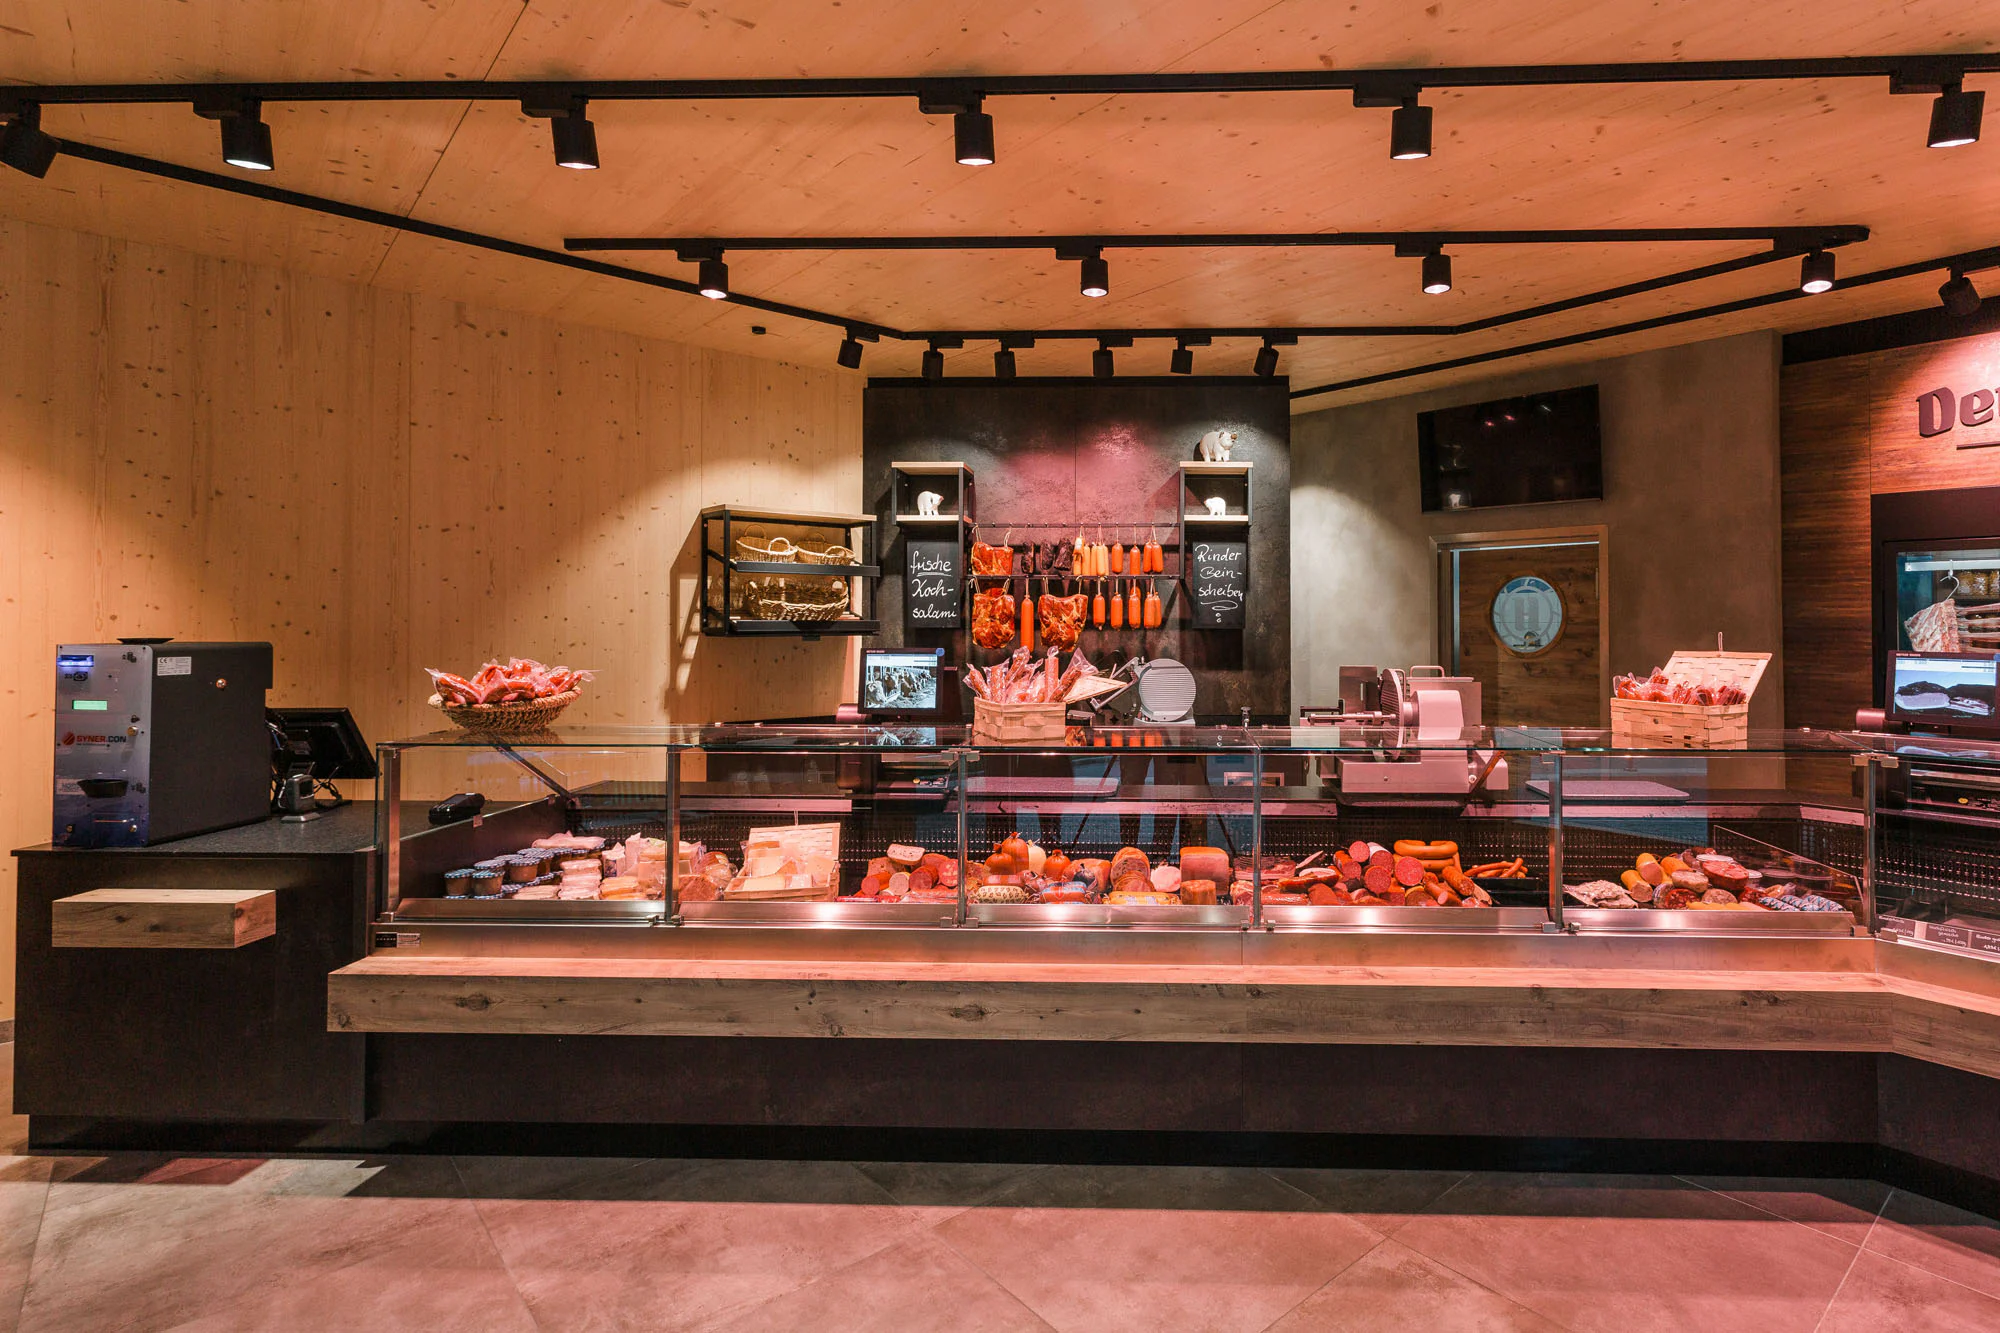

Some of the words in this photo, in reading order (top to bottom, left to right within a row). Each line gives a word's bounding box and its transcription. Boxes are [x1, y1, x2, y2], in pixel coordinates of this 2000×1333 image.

[1916, 387, 2000, 438] De
[910, 550, 952, 575] frische
[1194, 543, 1242, 563] Rinder
[1199, 566, 1243, 579] Bein-
[911, 578, 955, 598] Koch-
[1198, 583, 1244, 602] scheiben
[912, 602, 957, 619] salami
